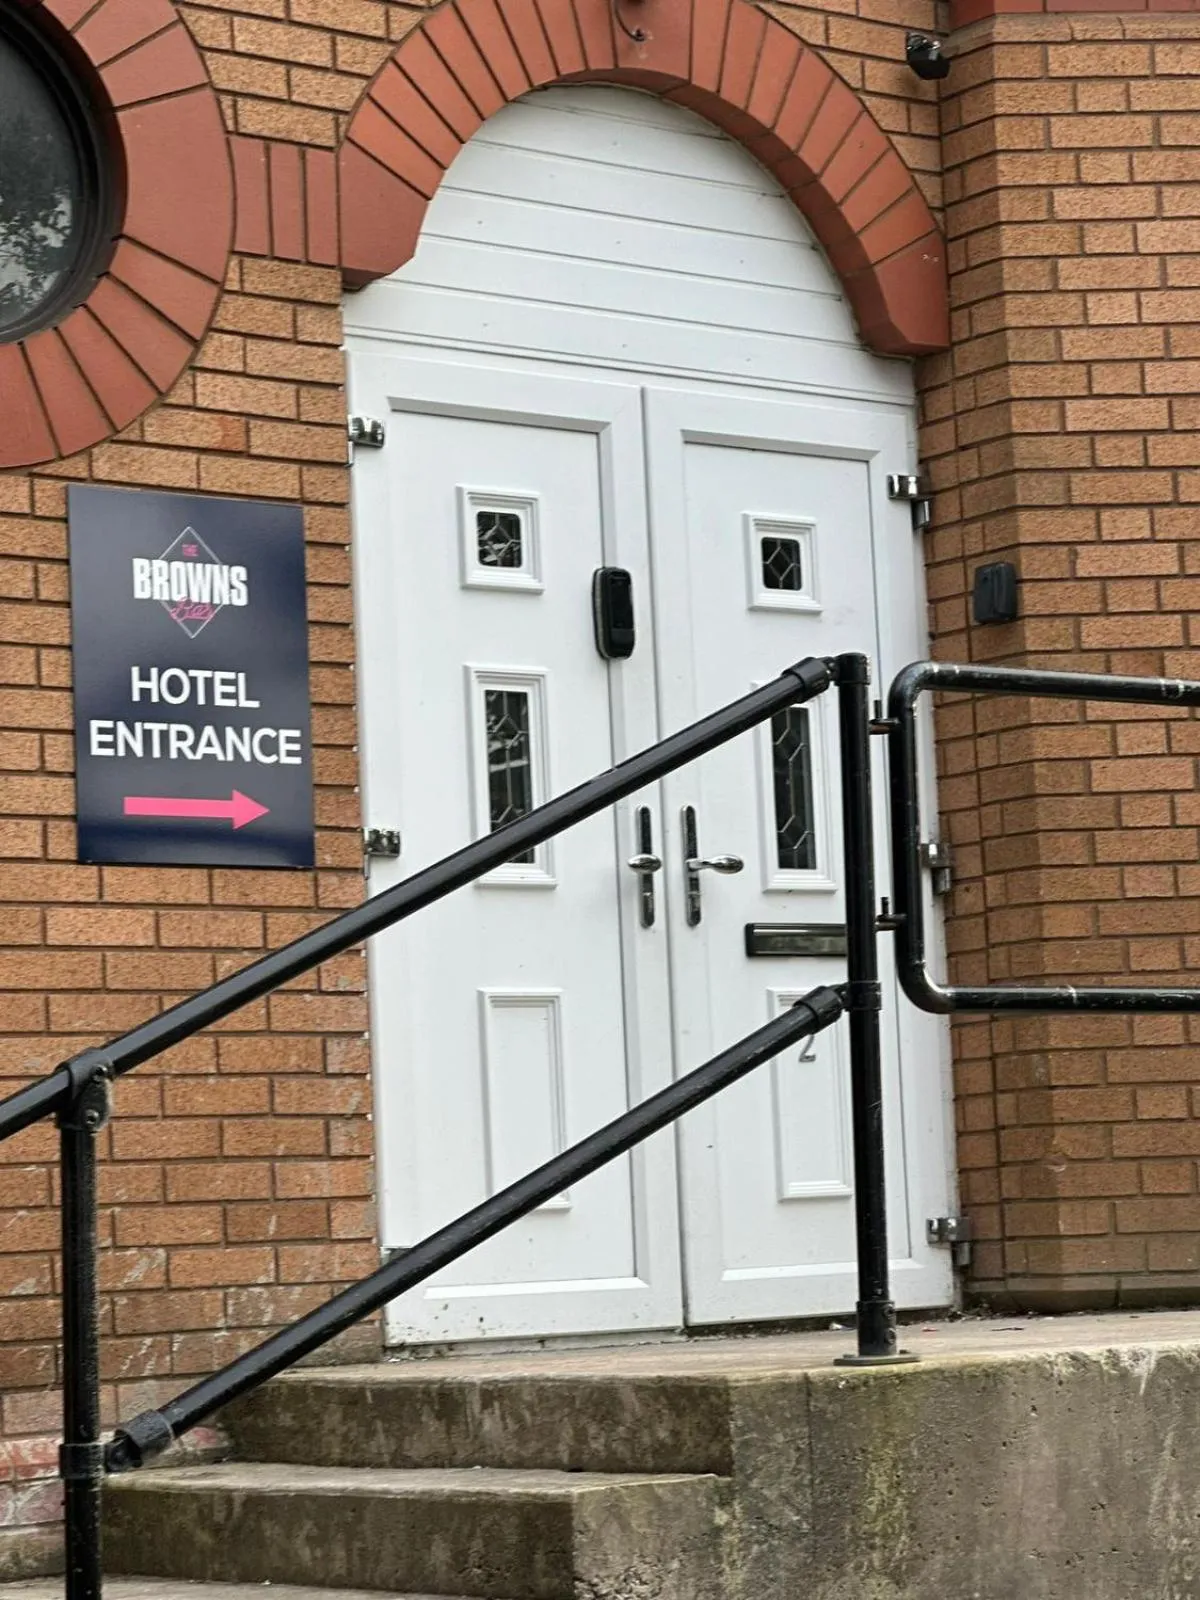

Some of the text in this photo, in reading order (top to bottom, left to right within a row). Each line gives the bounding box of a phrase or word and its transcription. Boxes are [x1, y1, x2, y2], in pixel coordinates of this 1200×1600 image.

[132, 557, 248, 606] BROWNS
[131, 666, 260, 708] HOTEL
[90, 719, 302, 764] ENTRANCE
